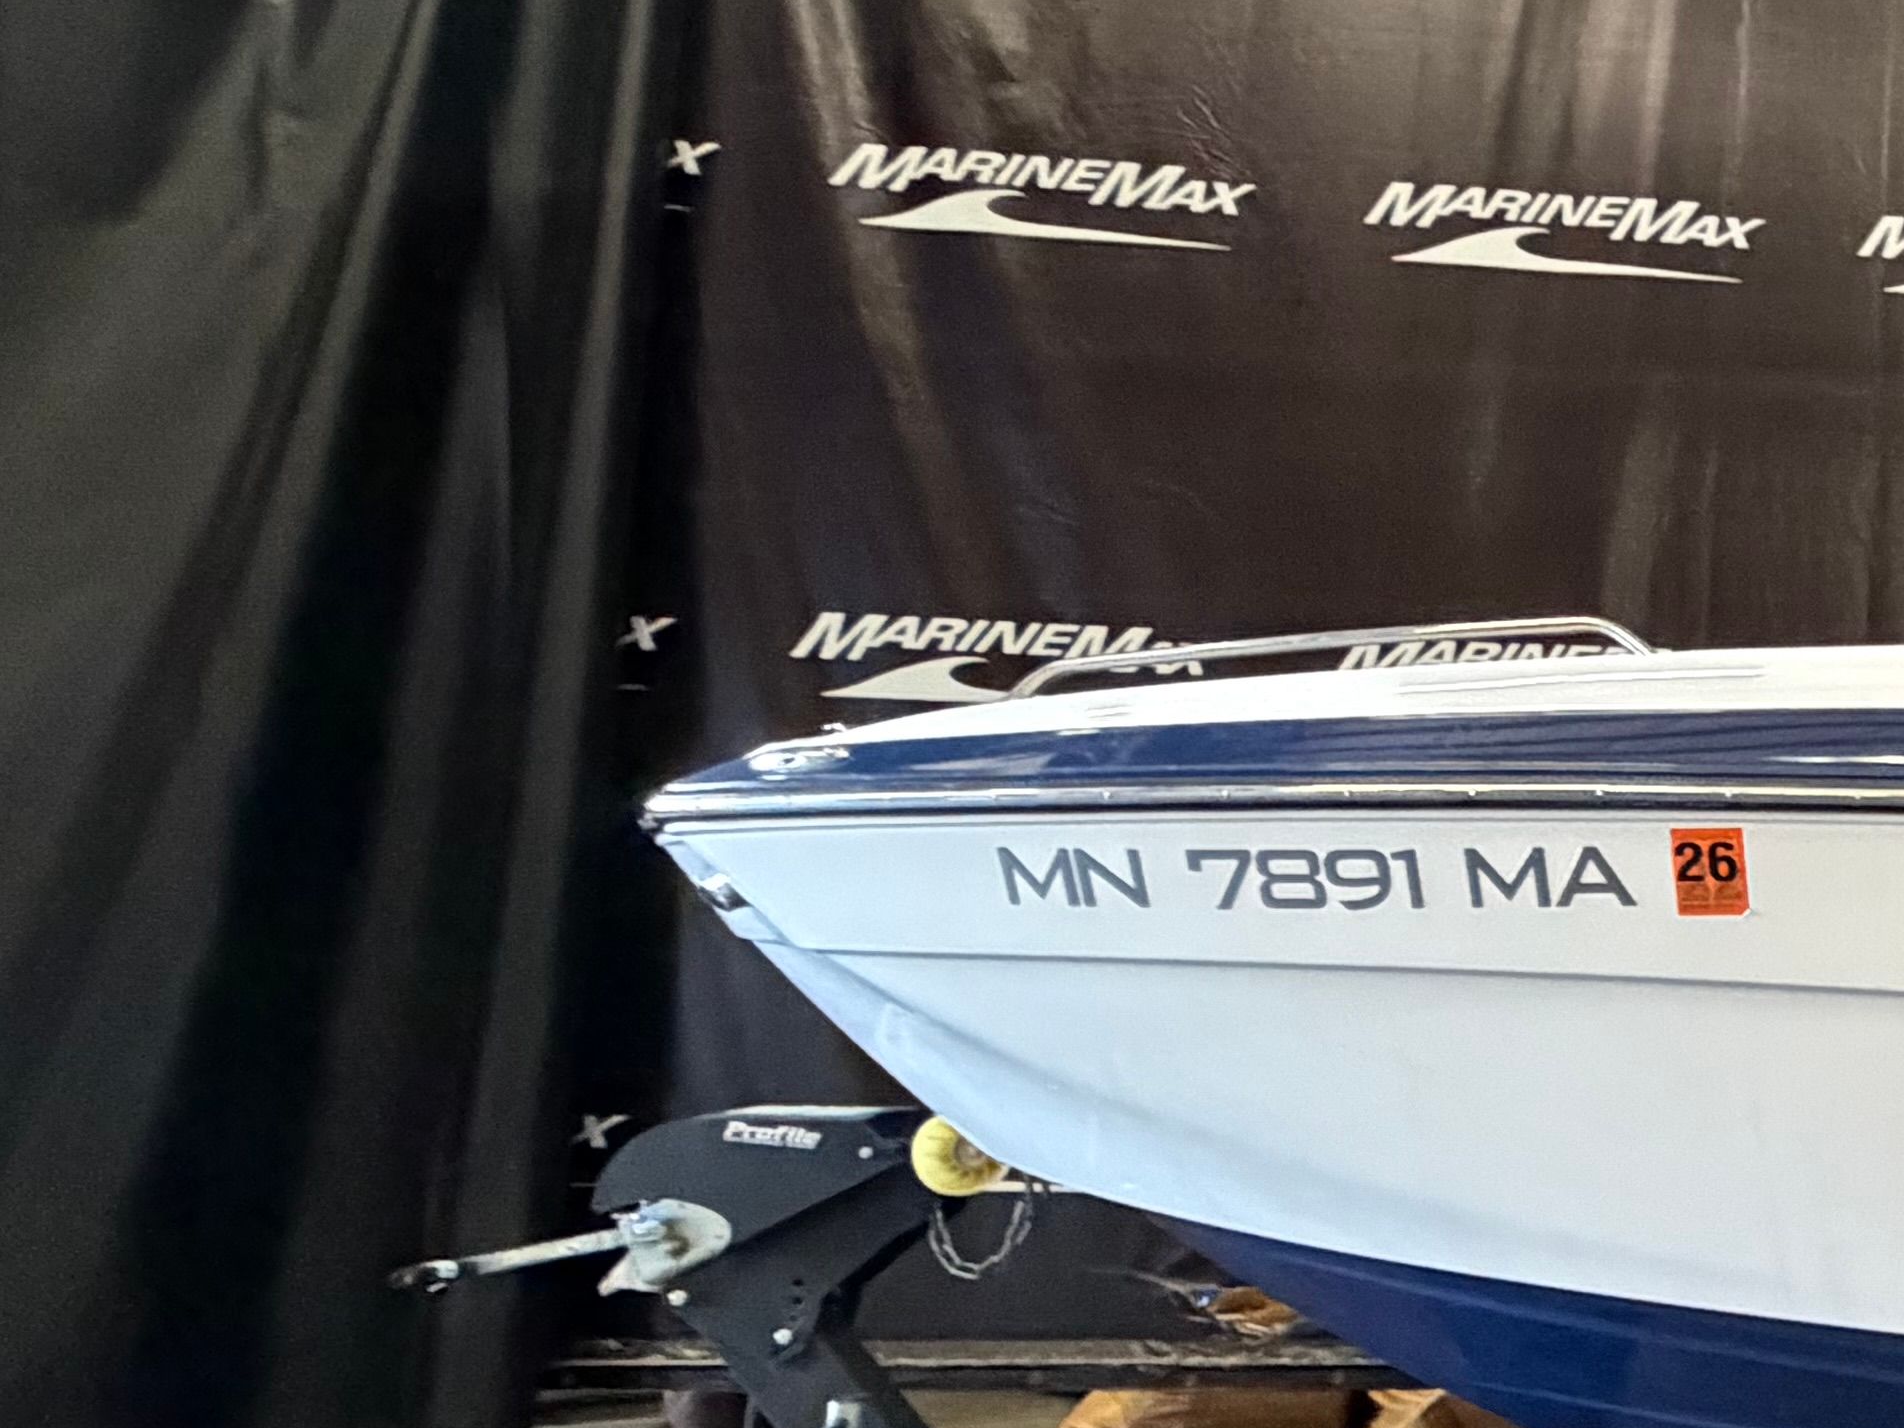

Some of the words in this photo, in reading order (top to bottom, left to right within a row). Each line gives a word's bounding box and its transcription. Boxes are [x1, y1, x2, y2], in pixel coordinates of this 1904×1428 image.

[828, 143, 1256, 215] MARINEMAX
[1364, 182, 1765, 248] MARINEMAX
[998, 845, 1152, 909] MN
[1185, 846, 1427, 912] 7891
[1465, 845, 1638, 909] MA
[1674, 841, 1738, 882] 26
